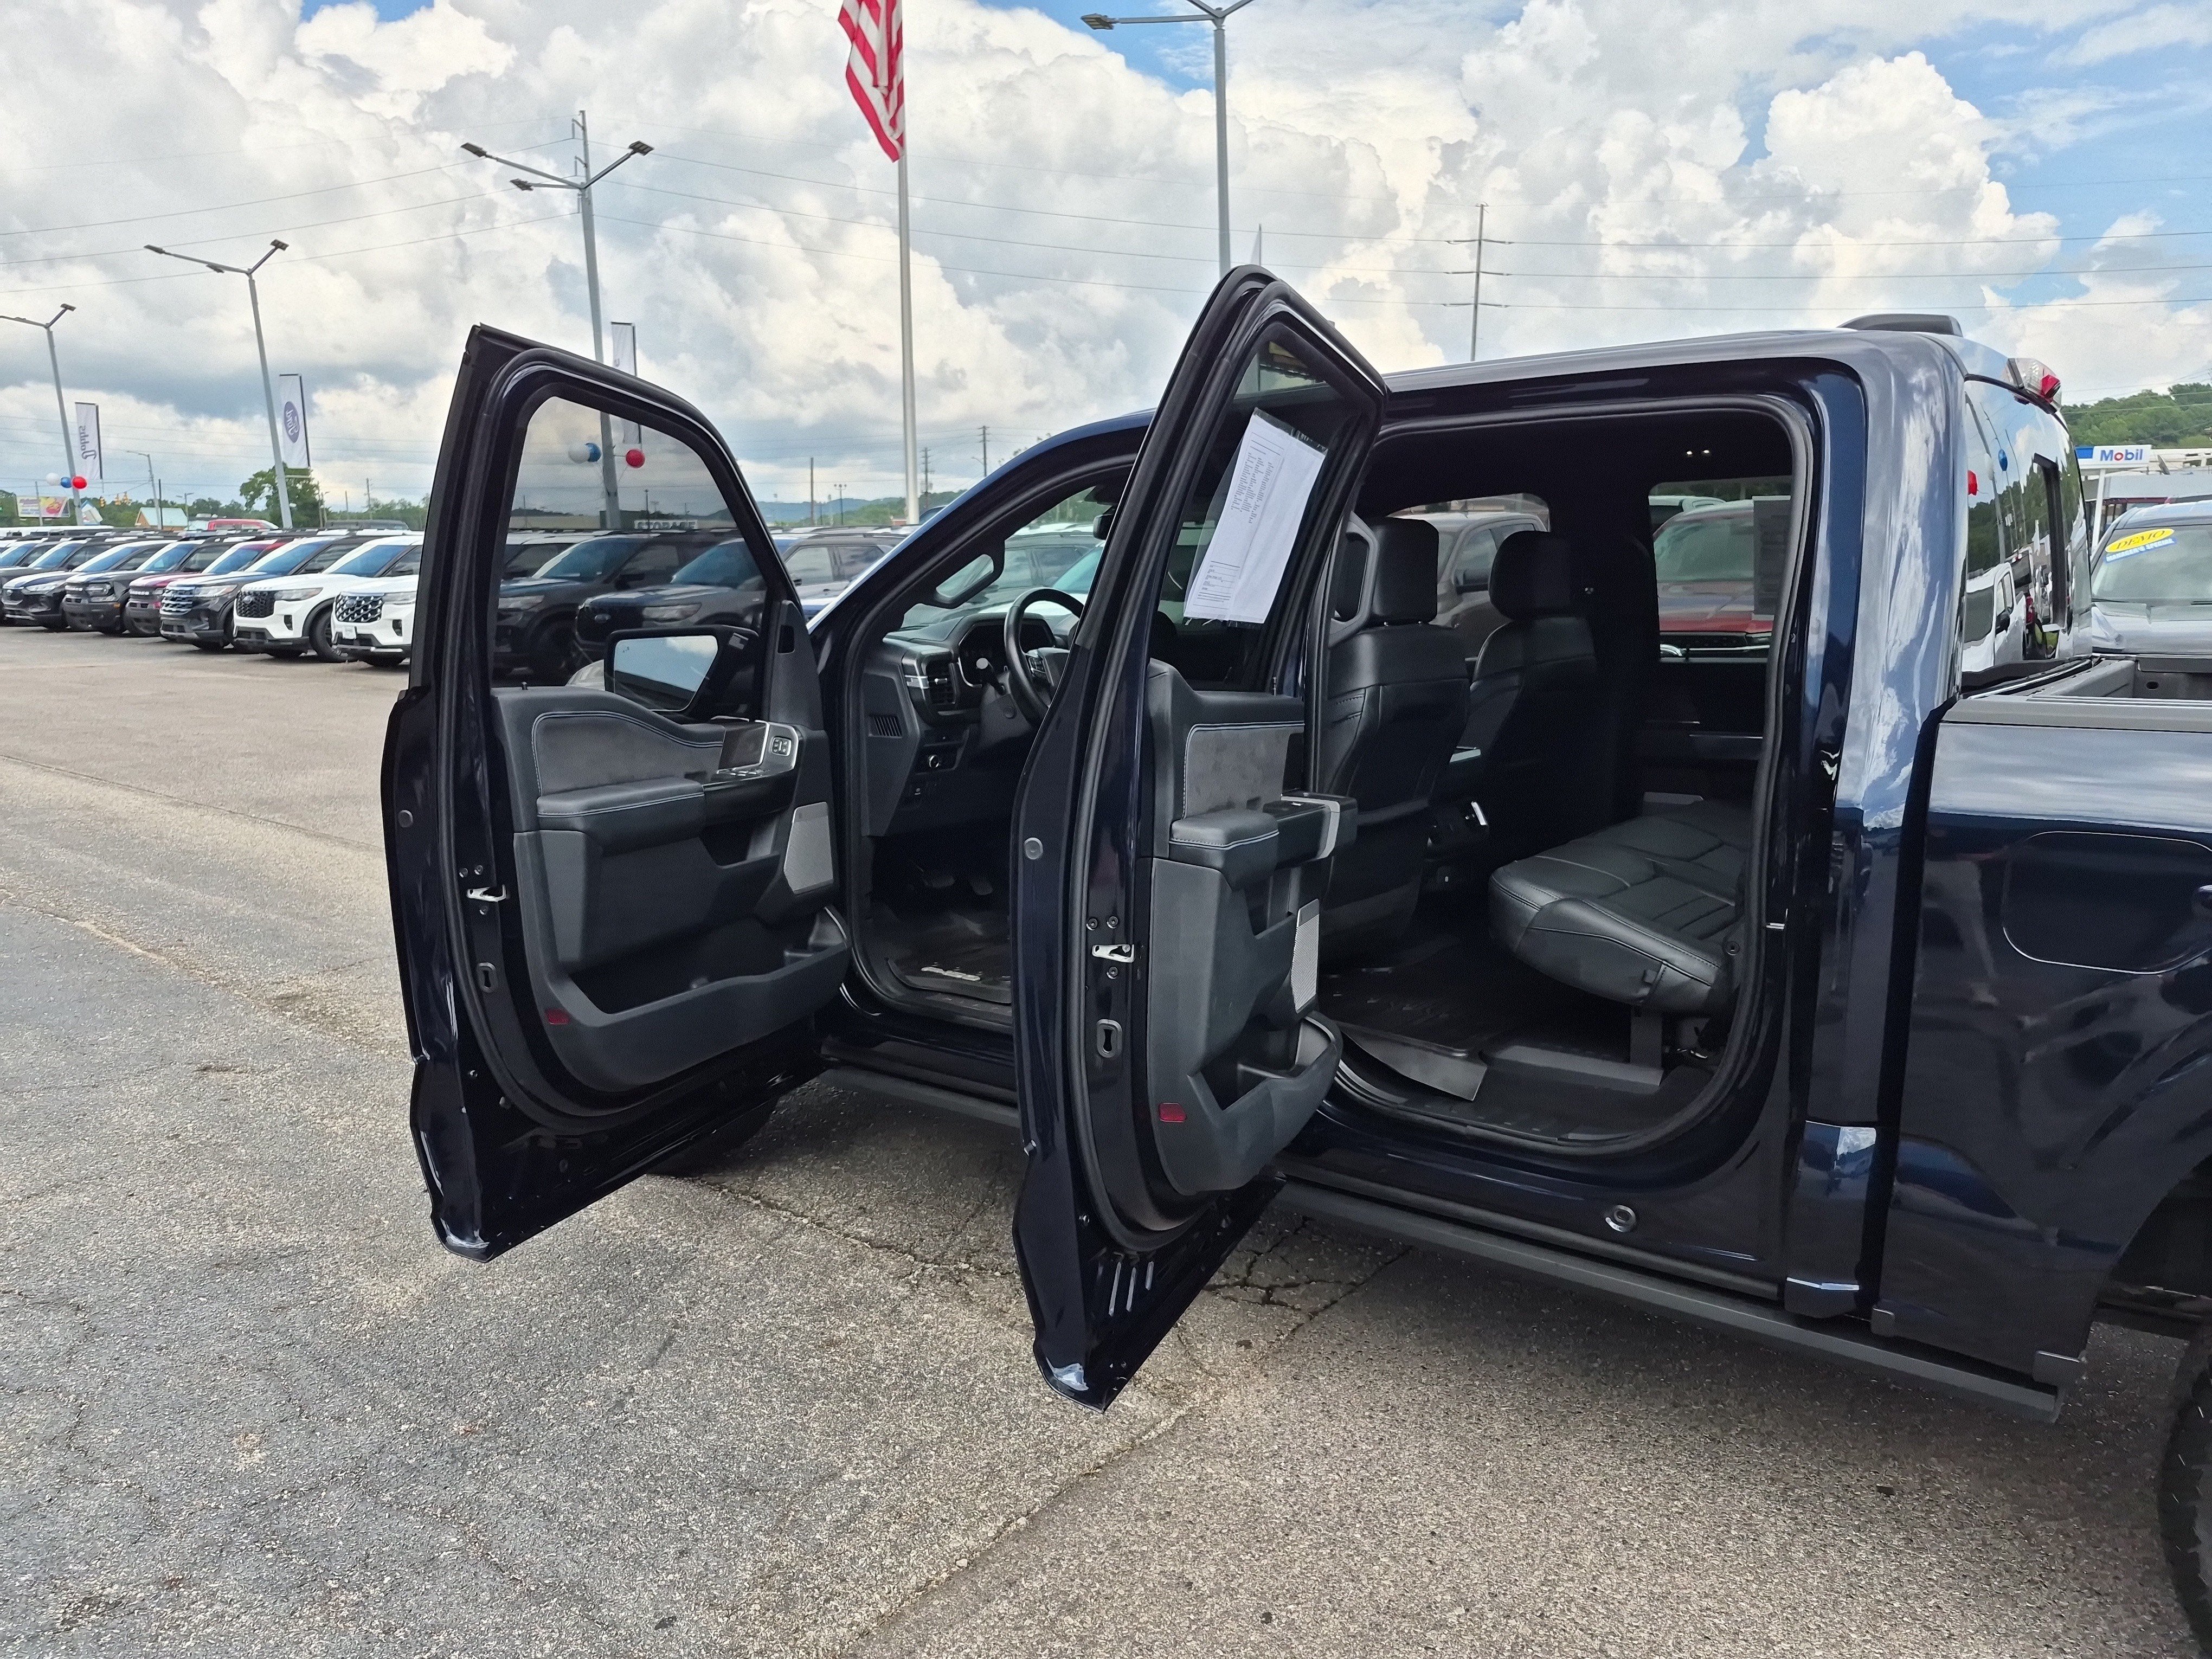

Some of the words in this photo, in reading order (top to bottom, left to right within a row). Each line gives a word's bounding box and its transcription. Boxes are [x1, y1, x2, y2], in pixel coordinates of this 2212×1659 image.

[2100, 449, 2143, 461] Mobil
[2116, 530, 2165, 550] DEMO
[2145, 538, 2175, 550] SPECIAL
